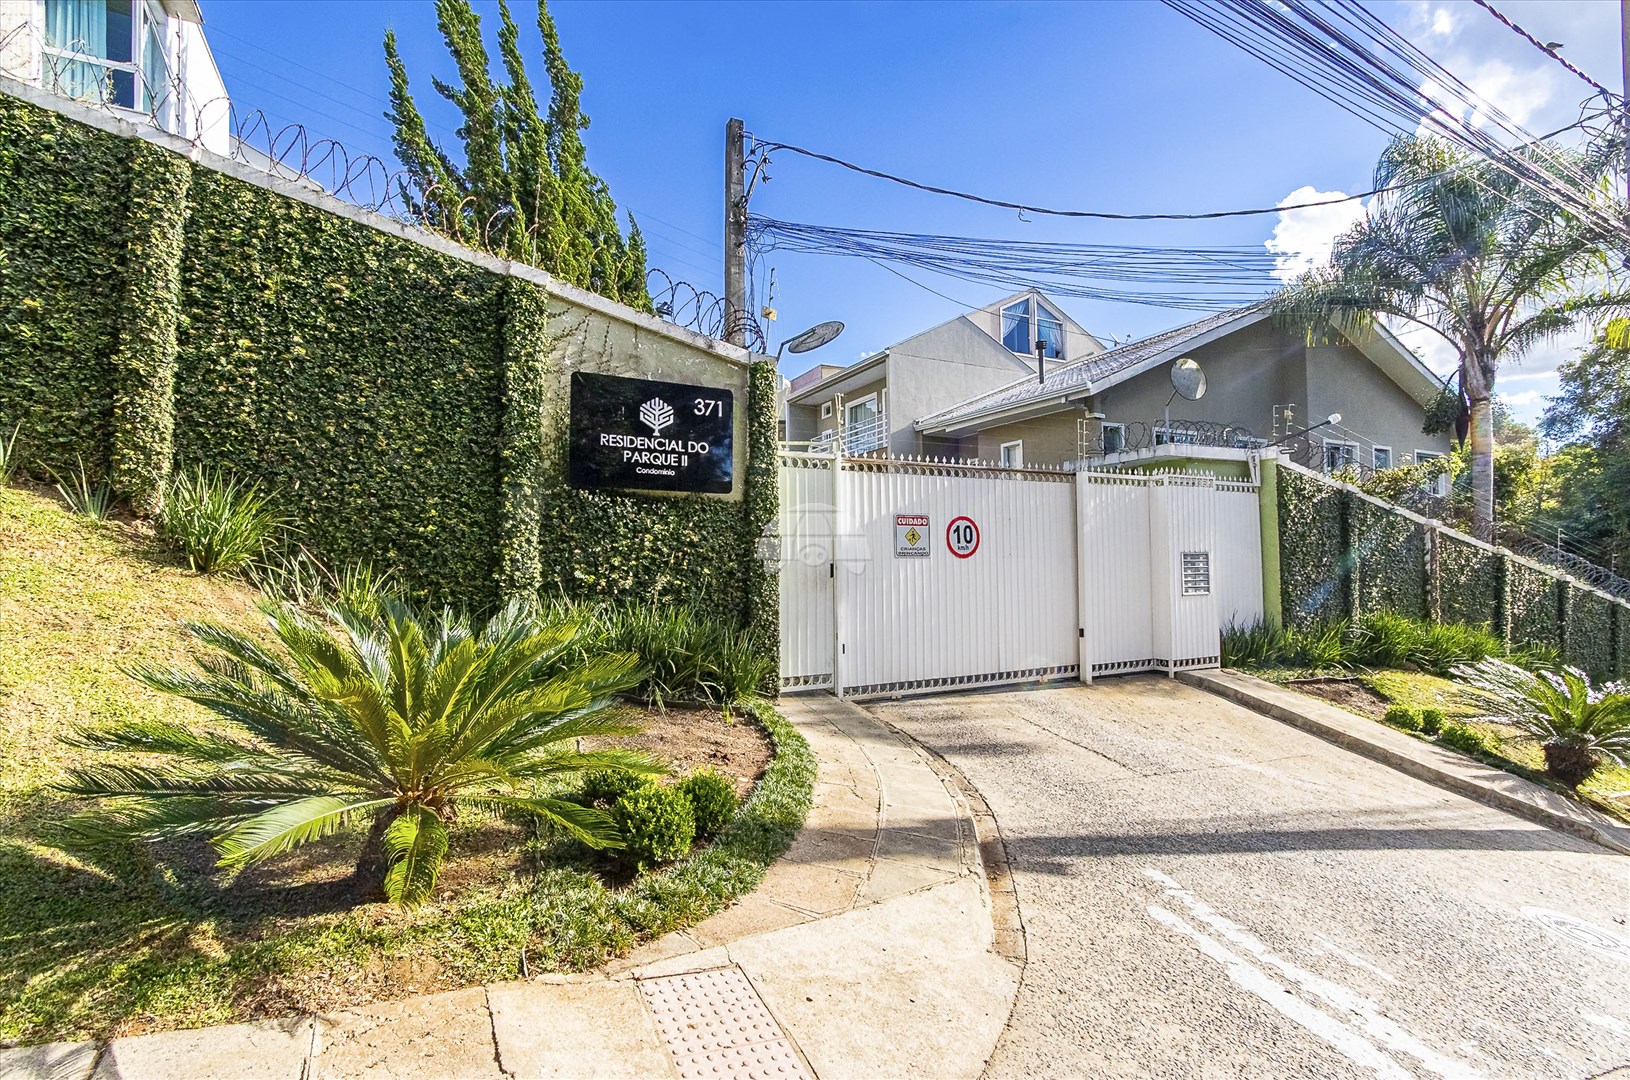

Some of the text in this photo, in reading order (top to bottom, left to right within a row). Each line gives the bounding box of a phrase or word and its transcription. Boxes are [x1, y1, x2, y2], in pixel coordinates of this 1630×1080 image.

[694, 398, 723, 417] 371
[600, 433, 709, 454] RESIDENCIAL DO
[623, 451, 688, 467] PARQUE II
[897, 517, 928, 525] CUIDADO
[953, 524, 973, 544] 10
